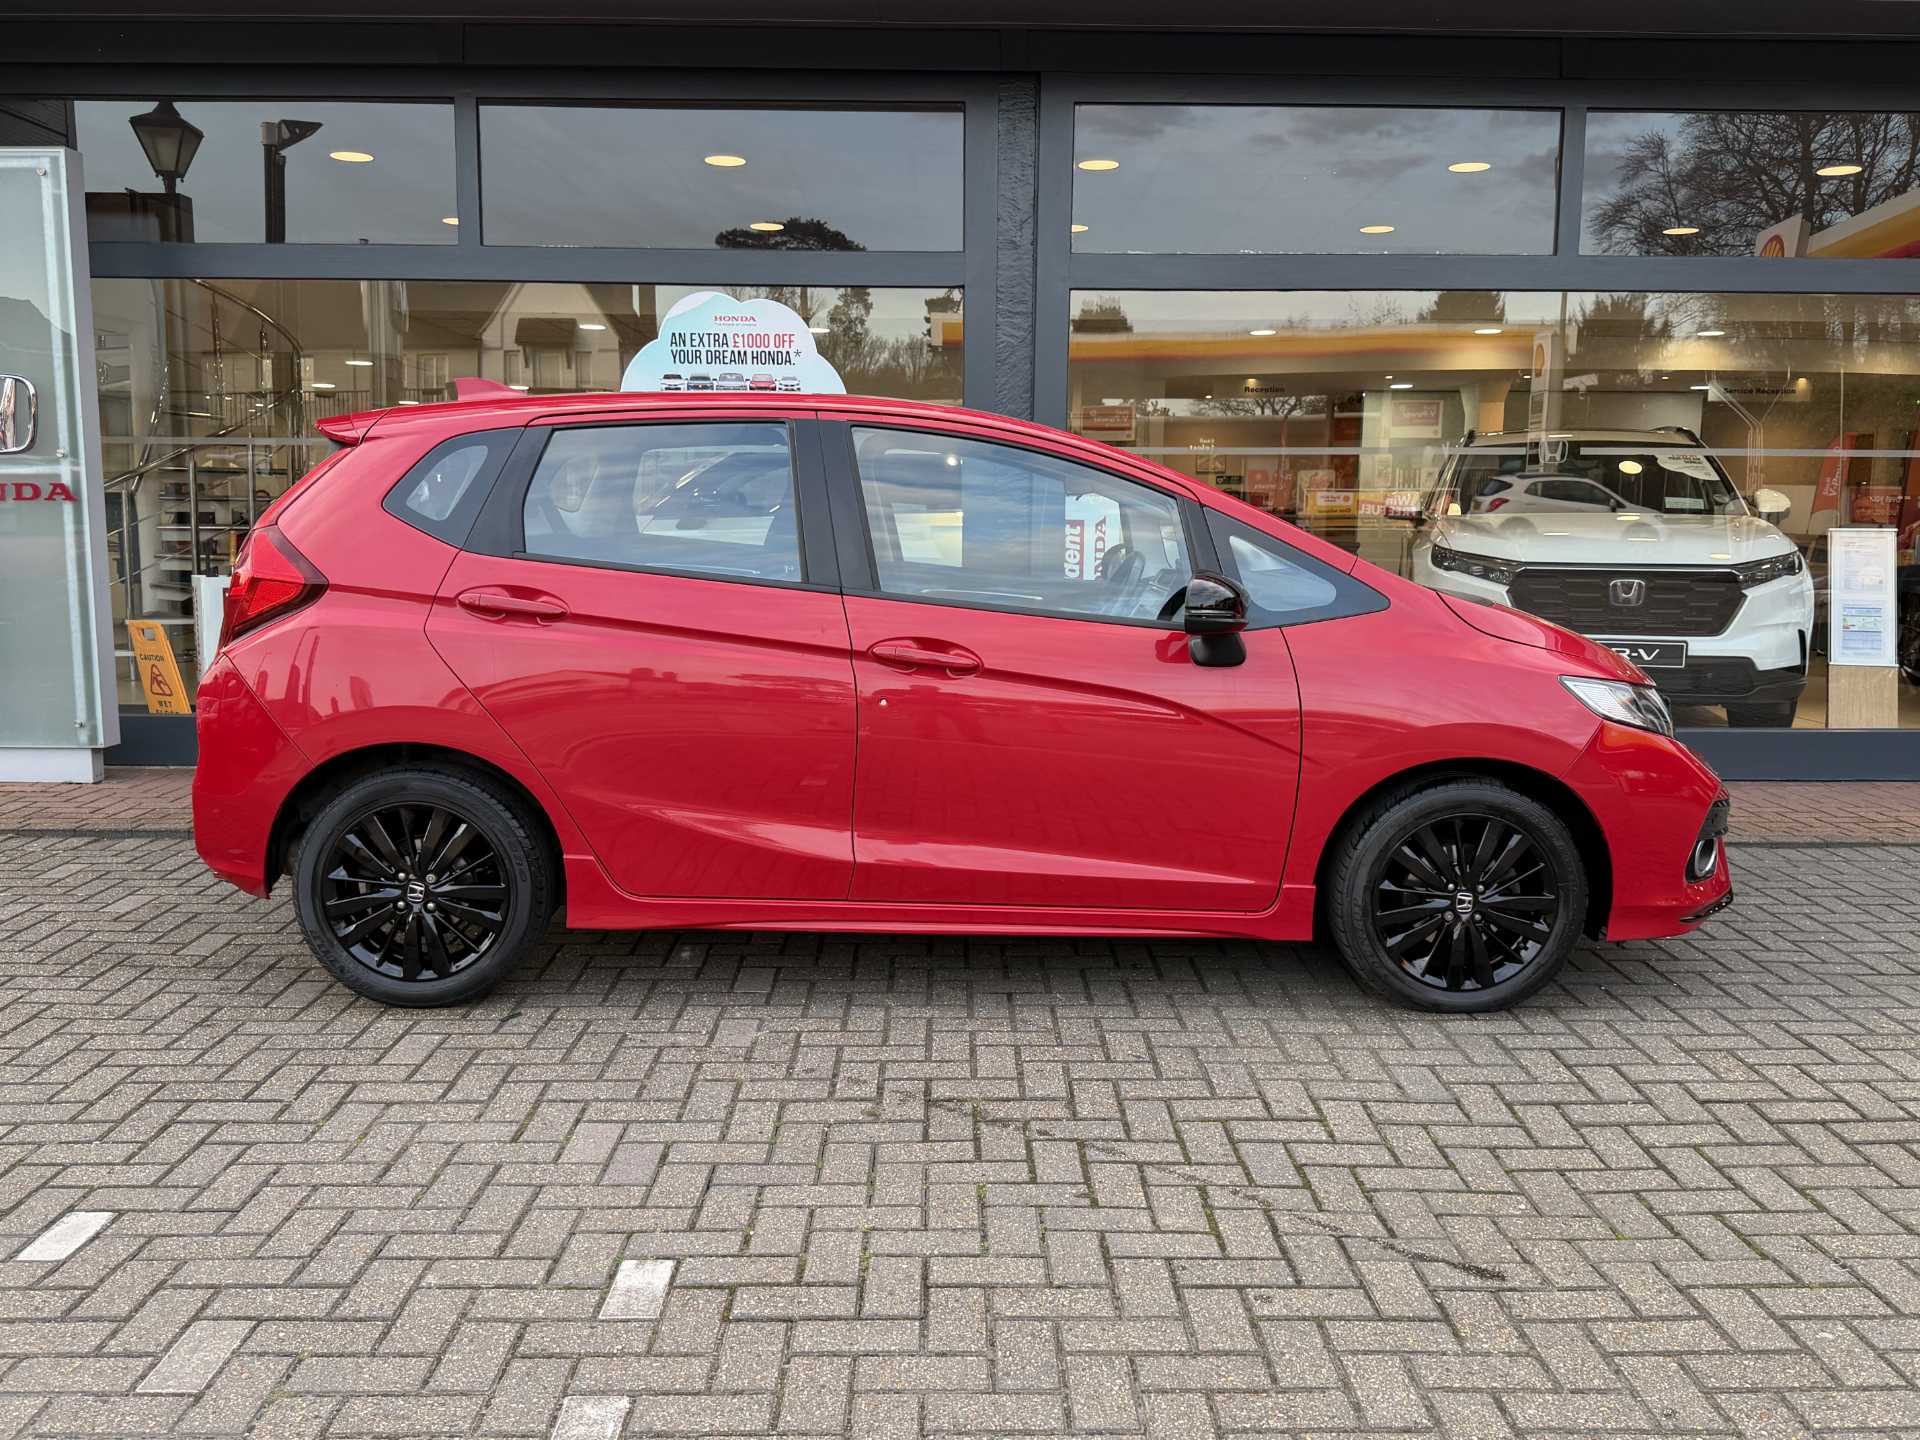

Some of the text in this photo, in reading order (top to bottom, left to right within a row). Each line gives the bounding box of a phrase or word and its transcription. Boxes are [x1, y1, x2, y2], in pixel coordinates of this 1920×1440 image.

[670, 332, 795, 349] AN EXTRA £1000 OFF
[671, 349, 702, 365] YOUR
[706, 350, 748, 365] DREAM
[0, 482, 79, 502] DA
[139, 653, 165, 662] CAUTION
